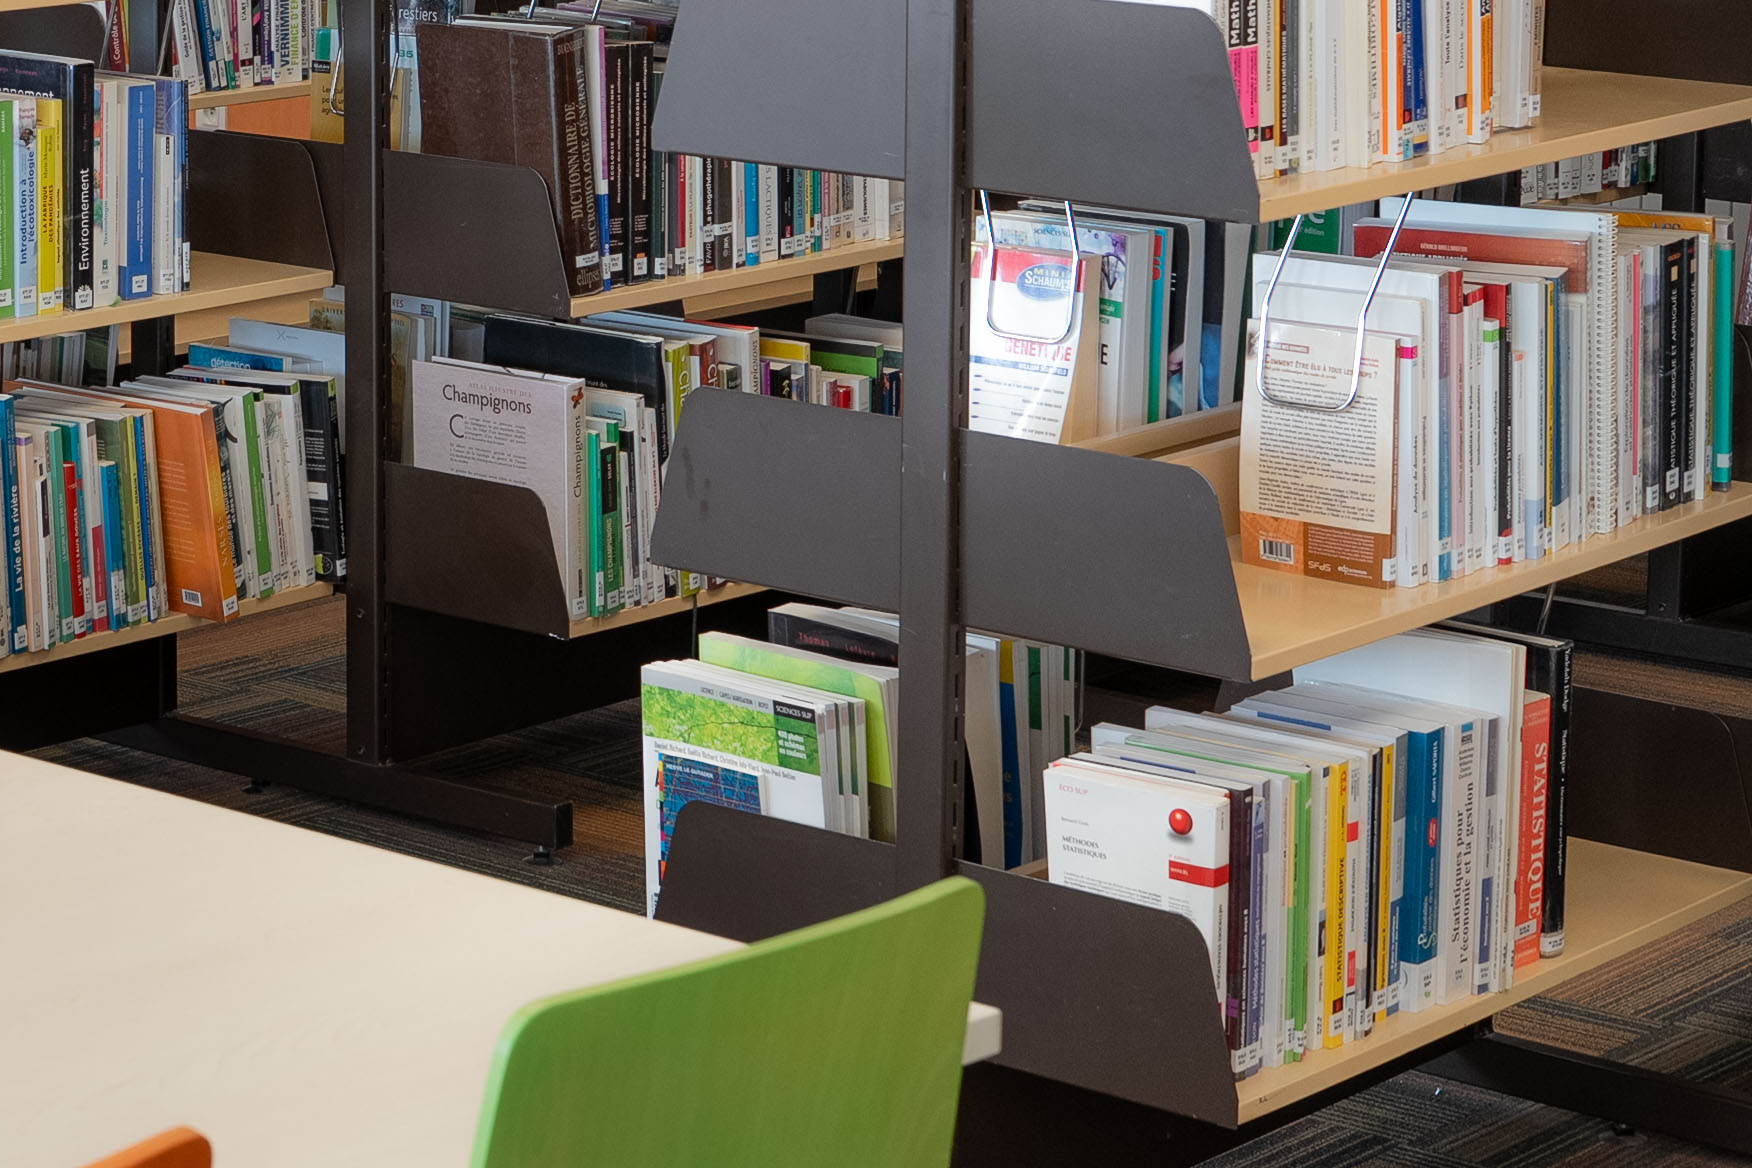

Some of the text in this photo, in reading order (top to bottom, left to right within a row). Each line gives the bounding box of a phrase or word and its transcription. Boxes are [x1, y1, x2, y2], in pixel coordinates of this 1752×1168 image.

[27, 151, 35, 242] l'écotoxicologie
[564, 102, 583, 219] DICTIONNAIRE DE
[581, 139, 597, 248] MICROBIOLOGIE
[78, 168, 90, 271] Environnement
[1033, 266, 1066, 278] MINI
[442, 383, 533, 415] Champignons
[574, 416, 582, 497] Champignons
[10, 485, 24, 591] La vie de la rivière
[775, 704, 812, 720] SCIENCES SUP
[1062, 835, 1099, 849] MÉTHODES
[1062, 844, 1107, 860] STATISTIQUES
[1452, 811, 1465, 943] Statistiques pour
[1460, 783, 1475, 963] l'économie et la gestion
[1528, 743, 1547, 918] STATISTIQUE
[1336, 857, 1345, 982] STATISTIQUE DESCRIPTIVE
